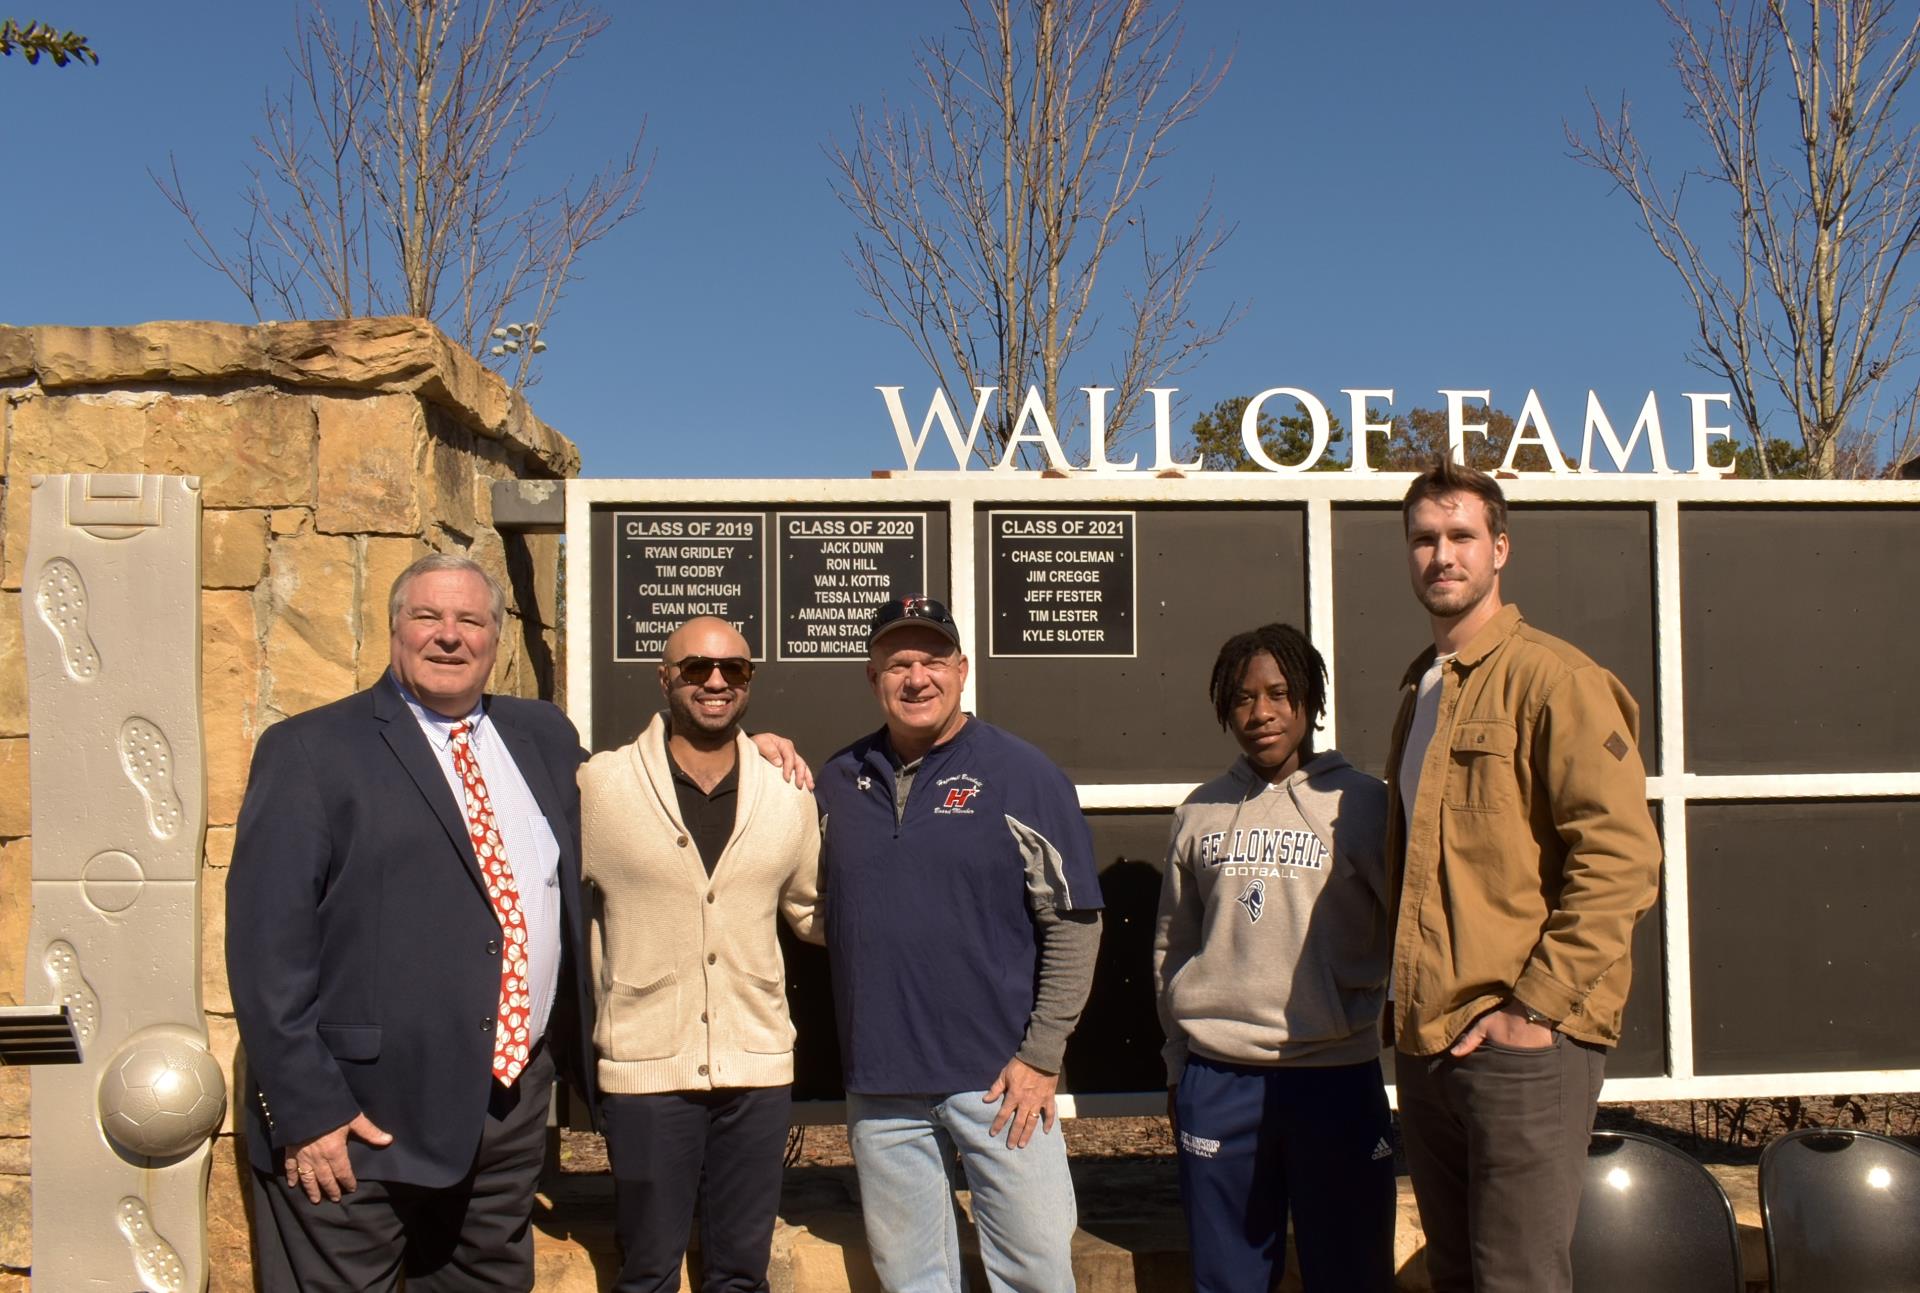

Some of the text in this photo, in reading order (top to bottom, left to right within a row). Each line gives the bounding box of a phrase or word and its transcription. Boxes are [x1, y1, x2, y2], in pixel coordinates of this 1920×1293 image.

[873, 385, 1736, 473] WALL OF FAME
[626, 522, 753, 536] CLASS OF 2019
[789, 521, 914, 535] CLASS OF 2020
[1001, 520, 1124, 534] CLASS OF 2021
[645, 547, 734, 559] RYAN GRIDLEY
[820, 542, 883, 554] JACK DUNN
[1011, 551, 1114, 563] CHASE COLEMAN
[826, 558, 877, 570] RON HILL
[656, 565, 724, 577] TIM GODBY
[1026, 570, 1100, 583] JIM CREGGE
[814, 575, 890, 587] VAN J. KOTTIS
[639, 584, 741, 596] COLLIN MCHUGH
[1024, 590, 1102, 602] JEFF FESTER
[815, 591, 890, 603] TESSA LYNAM
[652, 603, 728, 615] EVAN NOLTE
[798, 608, 878, 620] AMANDA MARS
[1029, 610, 1098, 622] TIM LESTER
[807, 624, 836, 637] RYAN
[1023, 630, 1104, 642] KYLE SLOTER
[787, 641, 818, 653] TODD
[1223, 866, 1299, 879] OOTBALL
